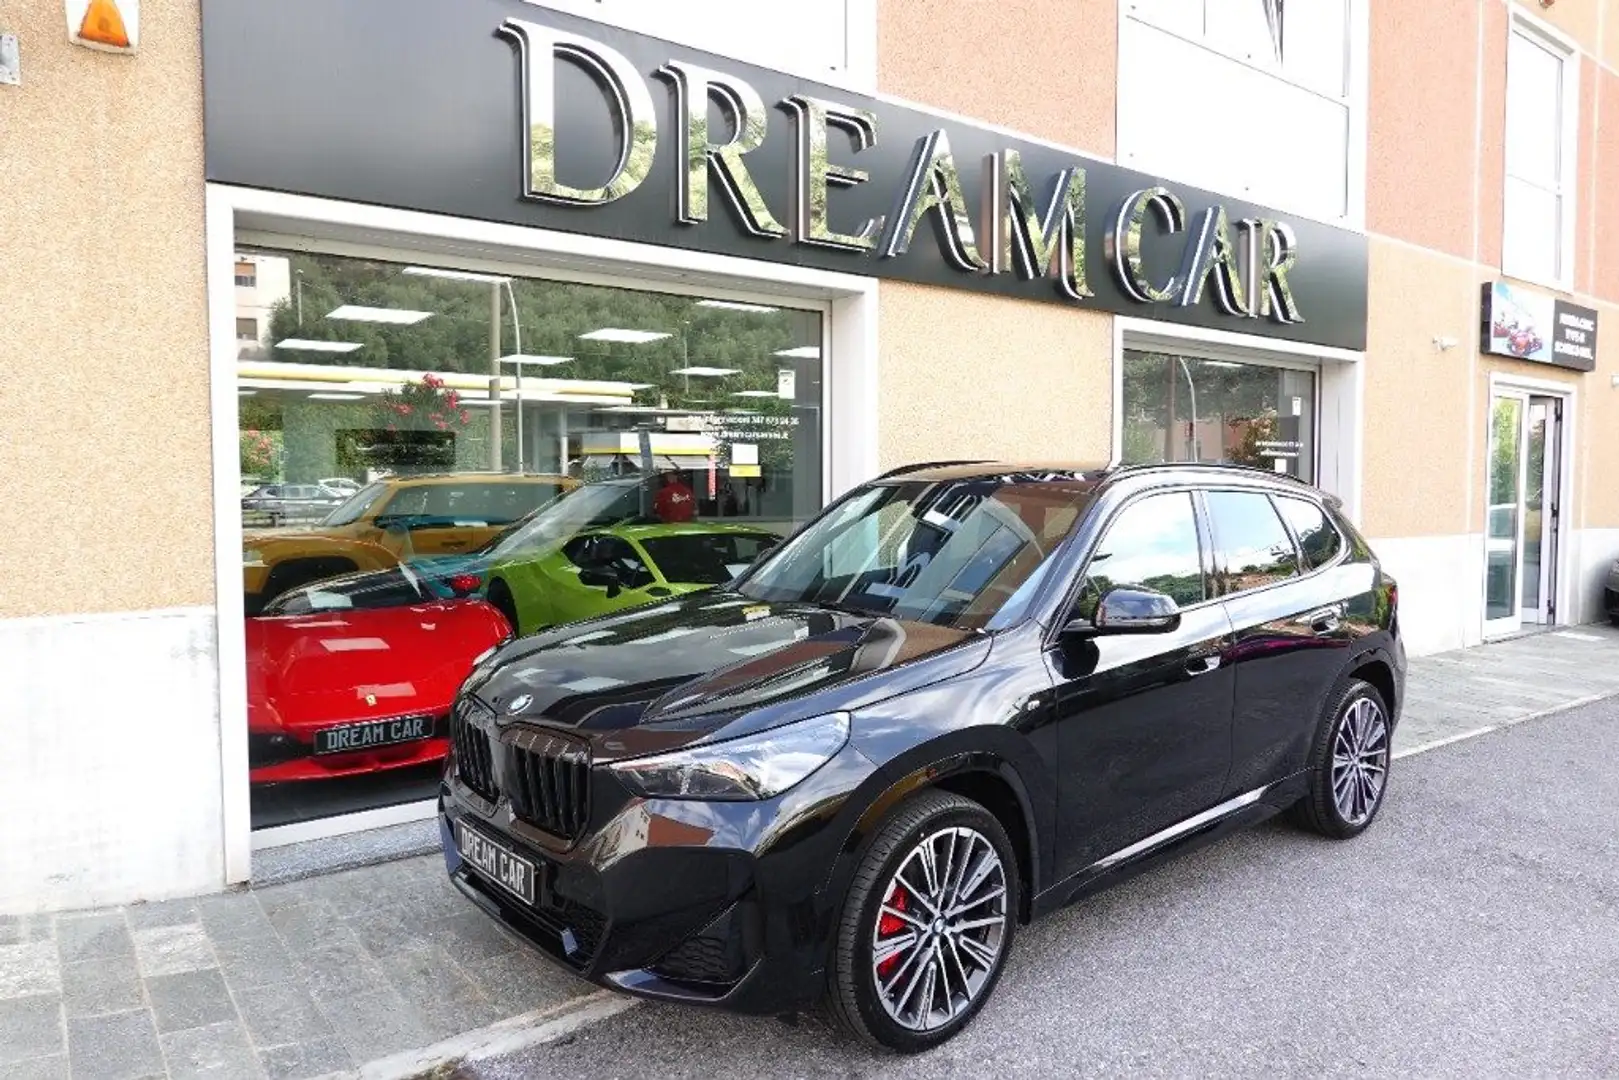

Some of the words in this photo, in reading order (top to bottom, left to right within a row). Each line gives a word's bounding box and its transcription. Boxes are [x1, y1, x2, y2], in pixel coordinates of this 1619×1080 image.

[494, 16, 1095, 301] DREAM
[1103, 185, 1306, 325] CAR
[326, 724, 385, 750] DREAM
[390, 718, 425, 740] CAR
[461, 826, 496, 876] DREAM
[500, 851, 525, 895] CAR
